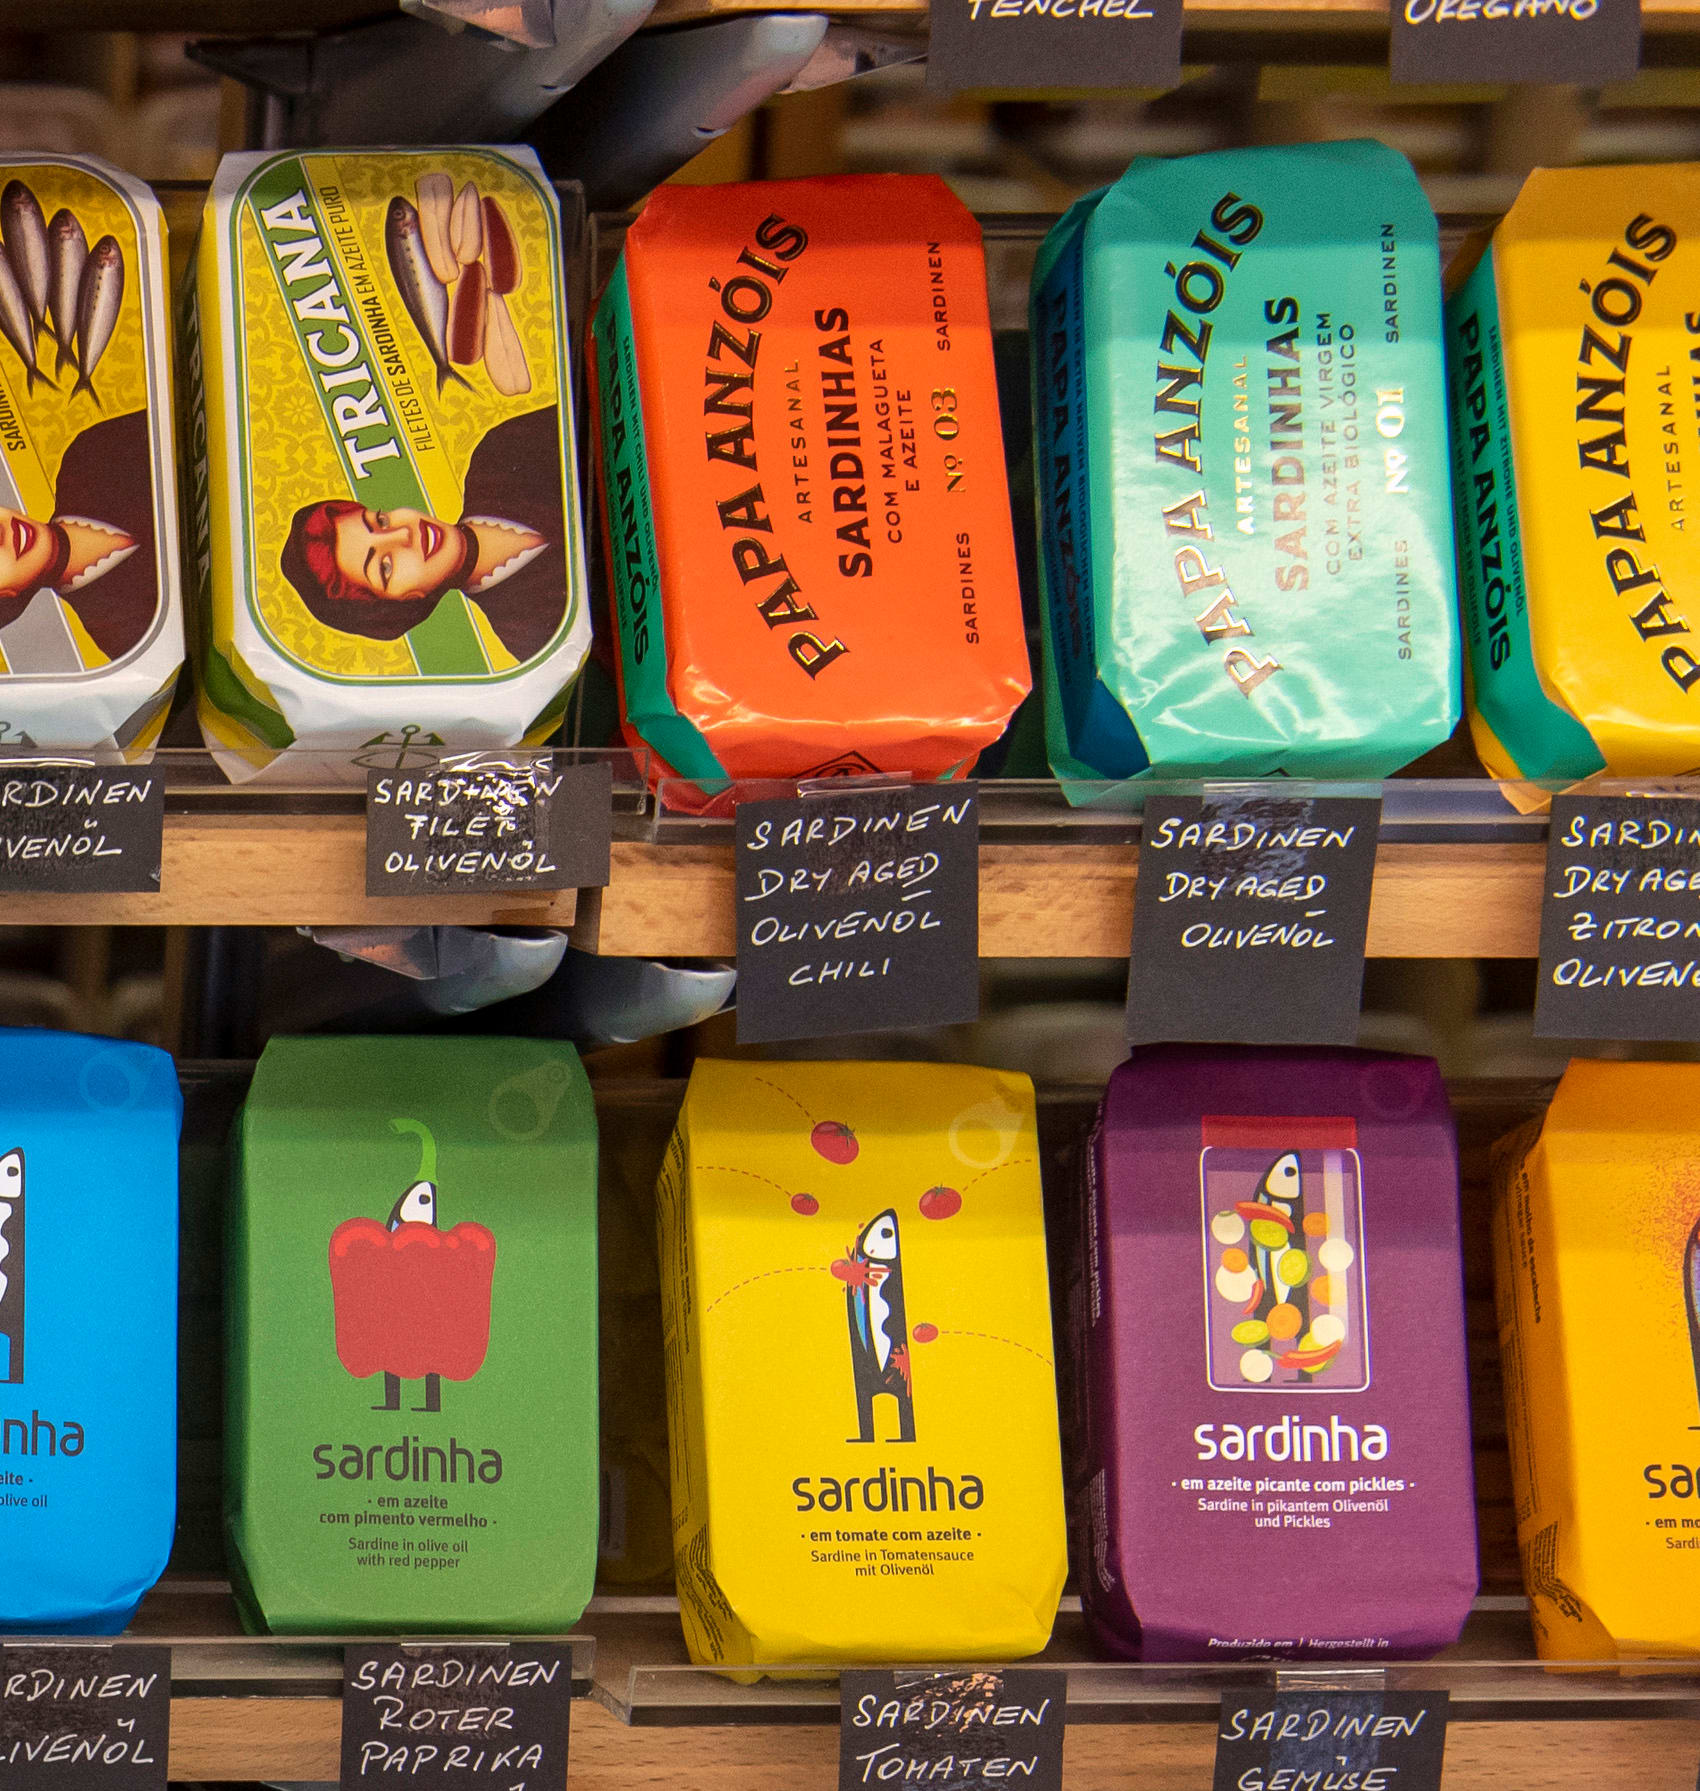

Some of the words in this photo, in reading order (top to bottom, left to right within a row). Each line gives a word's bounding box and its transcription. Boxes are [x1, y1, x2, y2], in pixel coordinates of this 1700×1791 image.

[925, 241, 950, 352] SARDINEN
[260, 189, 400, 482] TRICANA
[704, 213, 809, 471] ANZÓIS
[786, 358, 812, 524] ARTESANAL
[815, 308, 872, 580] SARDINHAS
[717, 482, 848, 680] PAPA
[957, 531, 979, 644] SARDINES
[1152, 818, 1353, 850] SARDINEN
[788, 959, 891, 986] CHILI
[312, 1436, 502, 1485] sardinha
[1194, 1415, 1388, 1463] sardinha
[33, 1493, 48, 1508] oil
[791, 1466, 984, 1514] sardinha
[379, 1698, 514, 1732] ROTER
[361, 1743, 544, 1772] PAPRIKA
[855, 1744, 1038, 1784] TOMATEN
